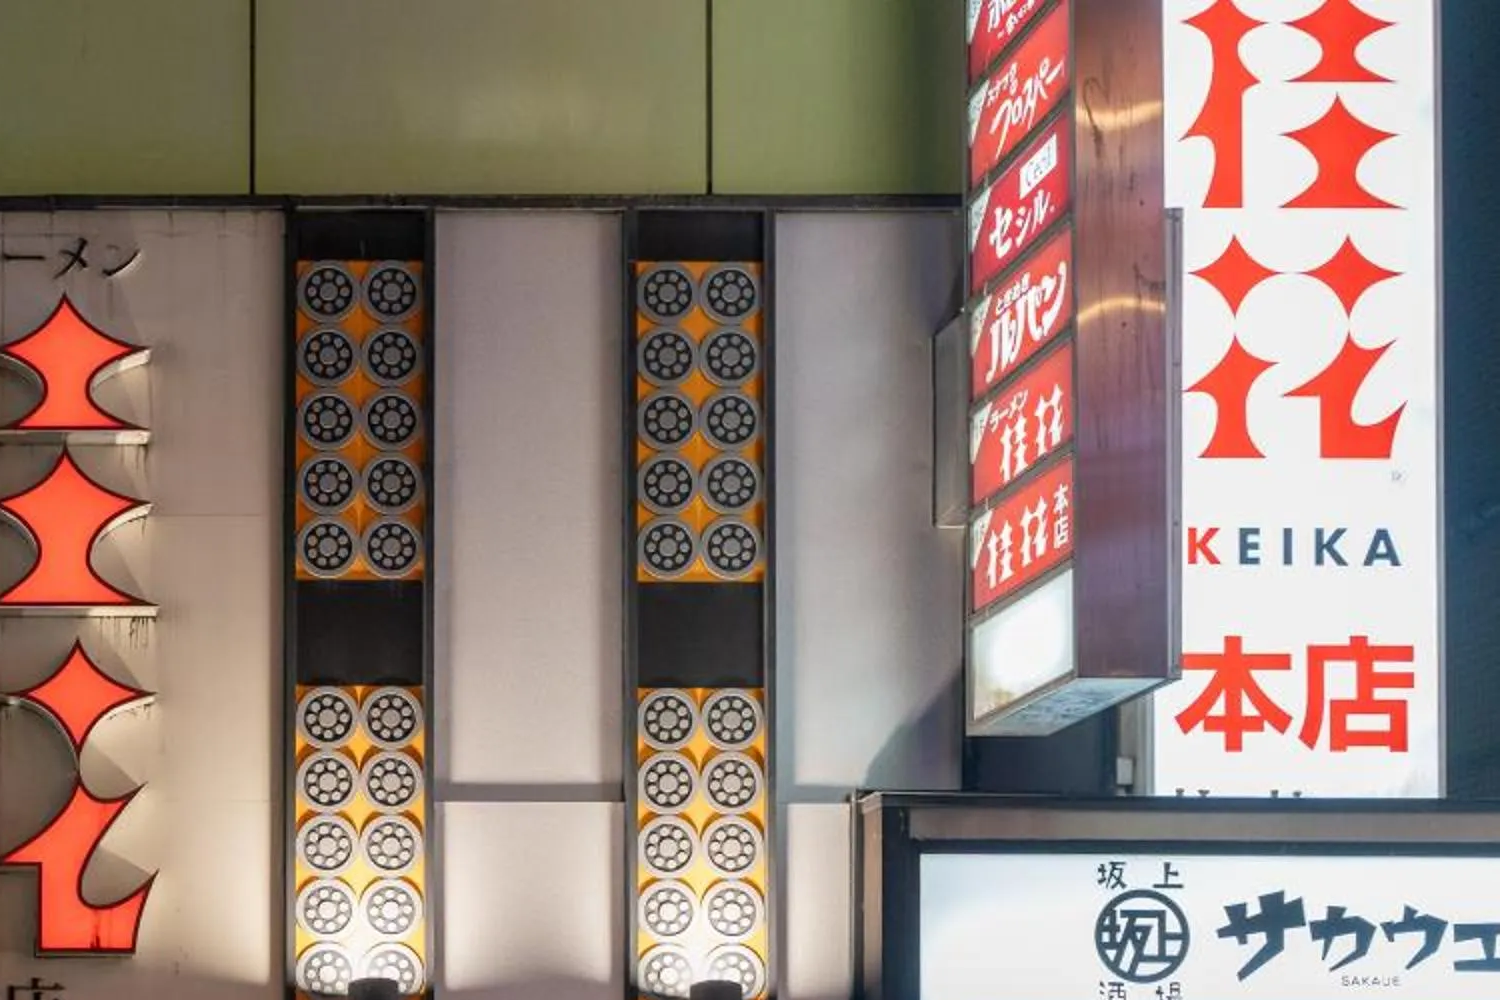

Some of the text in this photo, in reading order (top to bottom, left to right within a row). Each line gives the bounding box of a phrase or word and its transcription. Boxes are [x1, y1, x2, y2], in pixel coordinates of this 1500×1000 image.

[989, 190, 1050, 259] セシル
[1179, 0, 1409, 459] 桂花
[1053, 484, 1069, 549] 本店
[1187, 527, 1402, 566] KEIKA
[1175, 635, 1415, 752] 本店
[1216, 890, 1500, 982] サカウエ
[1341, 975, 1402, 987] SAKAUE
